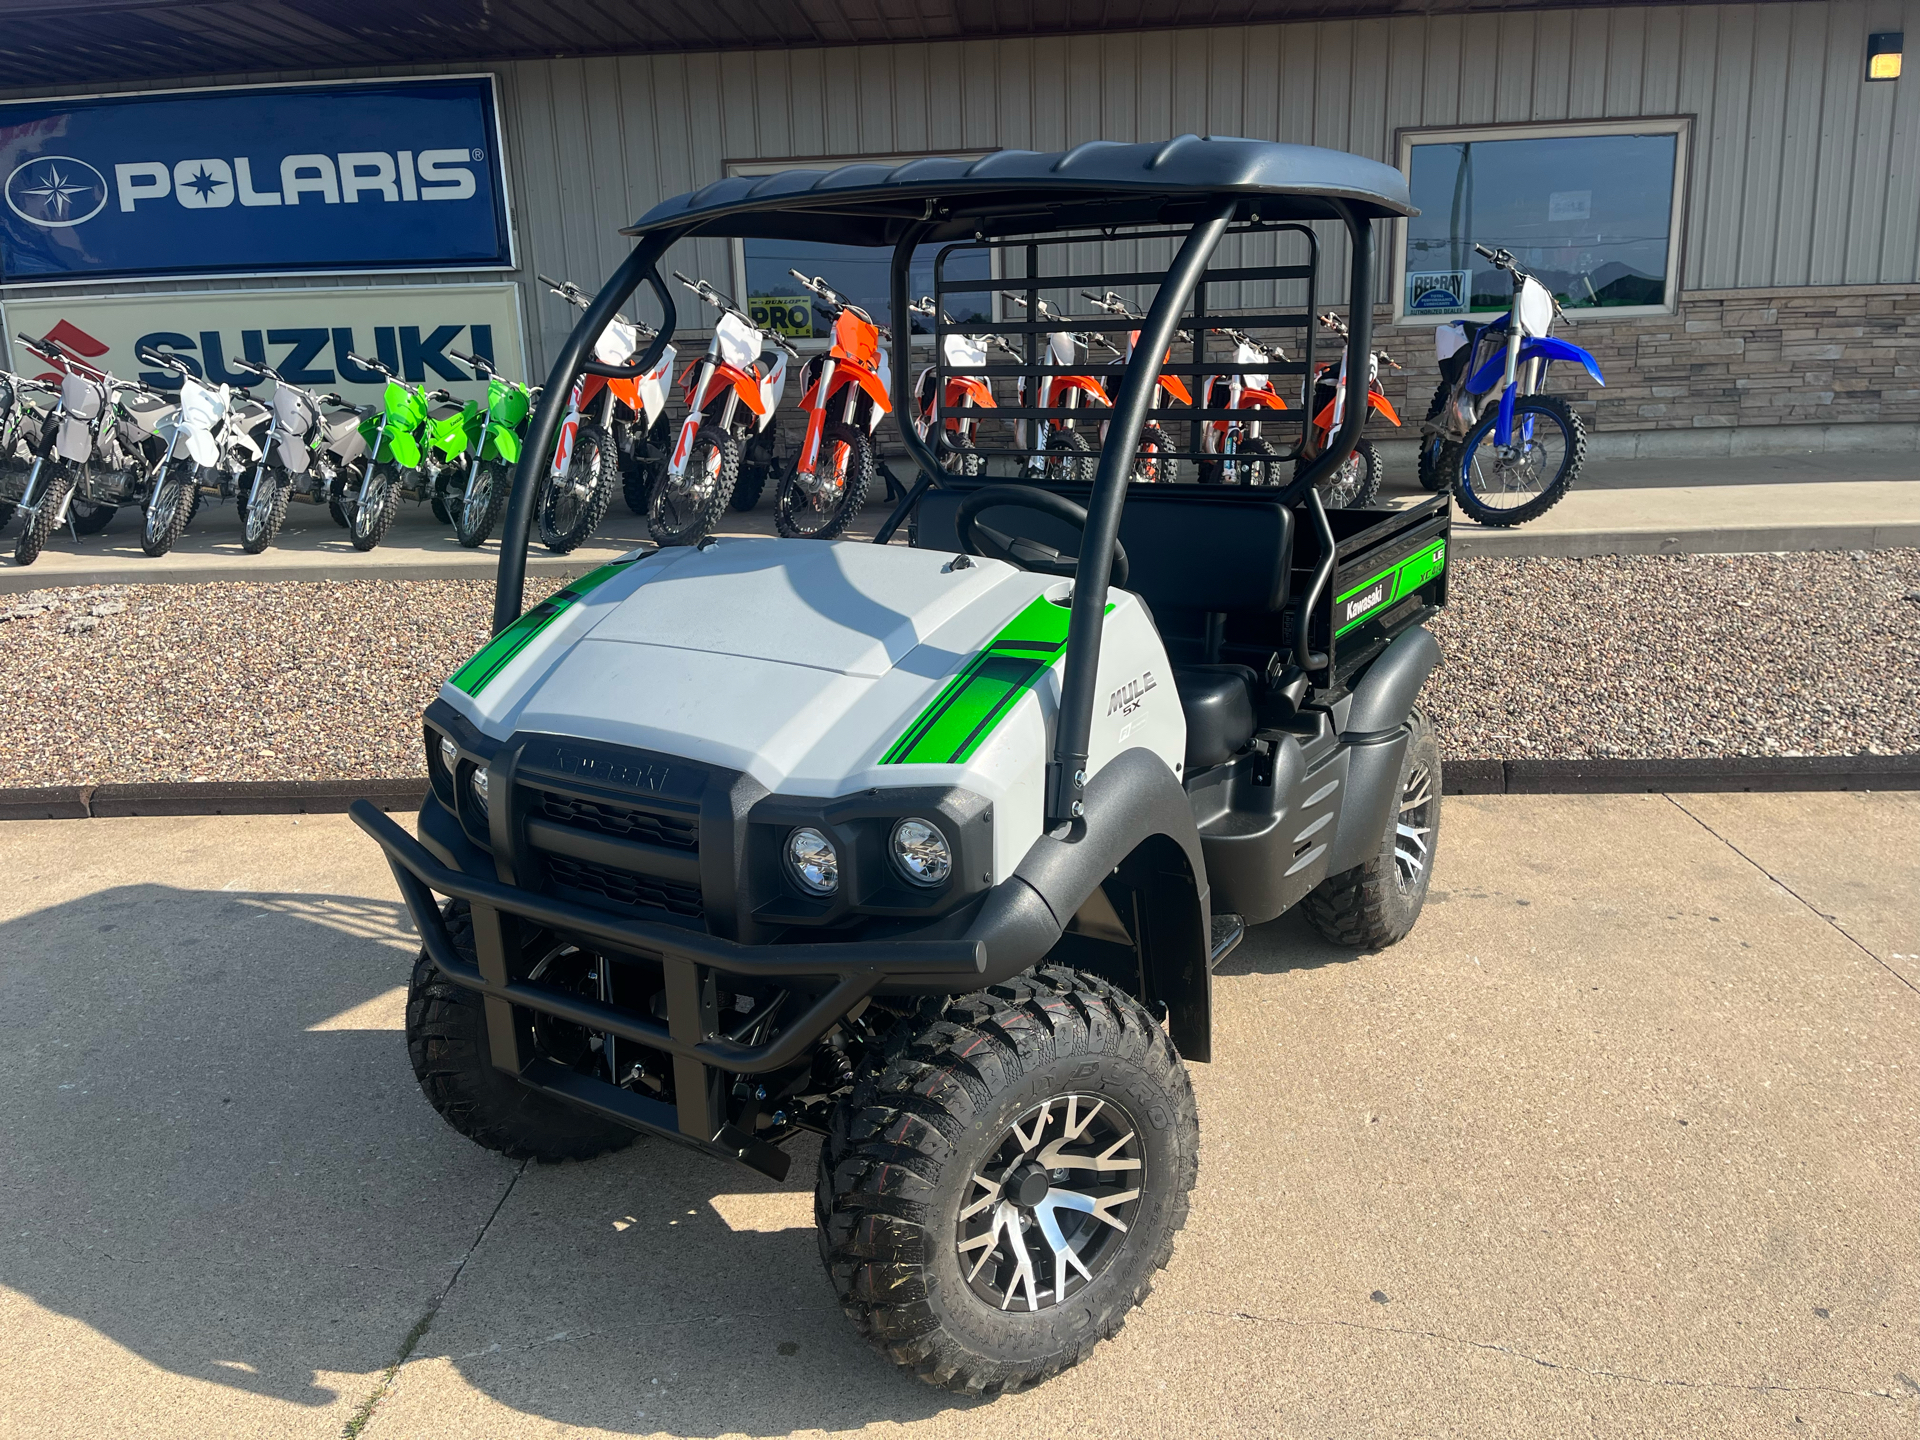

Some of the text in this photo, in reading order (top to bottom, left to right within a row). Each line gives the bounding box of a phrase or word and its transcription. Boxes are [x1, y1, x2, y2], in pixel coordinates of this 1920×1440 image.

[751, 305, 810, 329] PRO
[134, 324, 495, 390] SUZUKI
[1432, 548, 1444, 564] LE
[1346, 584, 1383, 621] Kawasaki
[1106, 670, 1157, 717] MULE
[1123, 699, 1141, 717] SX
